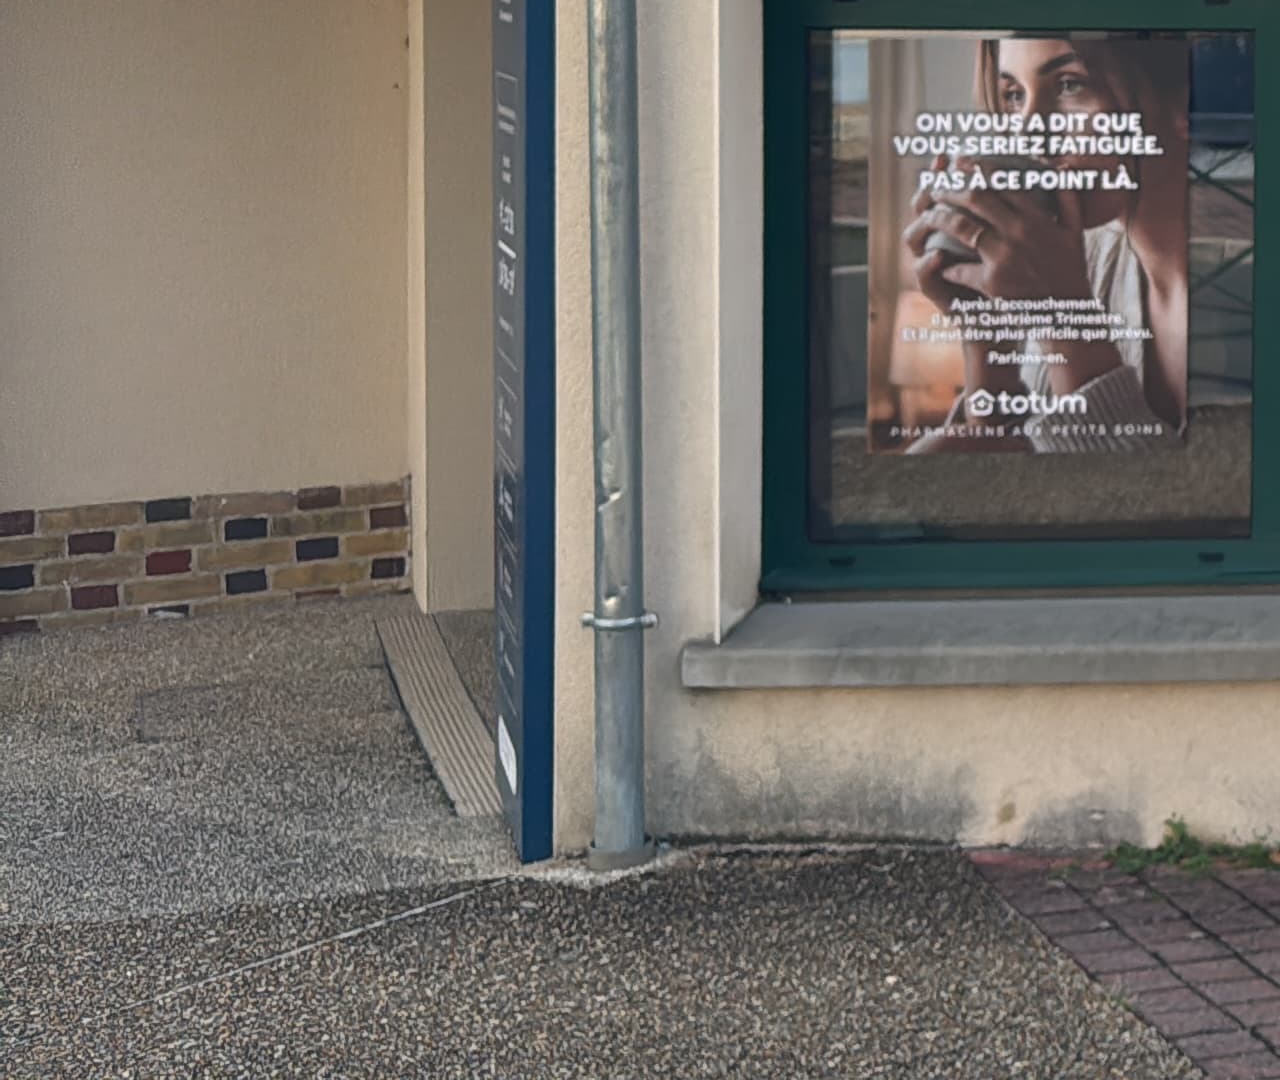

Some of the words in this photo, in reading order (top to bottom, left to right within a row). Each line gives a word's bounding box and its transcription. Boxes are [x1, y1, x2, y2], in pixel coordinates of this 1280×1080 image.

[916, 113, 952, 133] ON
[956, 113, 1022, 133] VOUS
[1026, 113, 1047, 133] A
[1051, 113, 1089, 133] DIT
[1092, 113, 1141, 135] QUE
[894, 135, 962, 155] VOUS
[964, 135, 1045, 155] SERIEZ
[1049, 129, 1163, 155] FATIGUÉE.
[919, 170, 964, 191] PAS
[970, 164, 988, 191] À
[991, 170, 1021, 191] CE
[1025, 170, 1098, 191] POINT
[1102, 164, 1138, 191] LÀ.
[1000, 393, 1087, 415] totum
[890, 424, 1005, 438] PHARMACIENS
[1012, 424, 1043, 438] AUX
[1052, 424, 1106, 438] PETITS
[1114, 424, 1163, 438] SOINS
